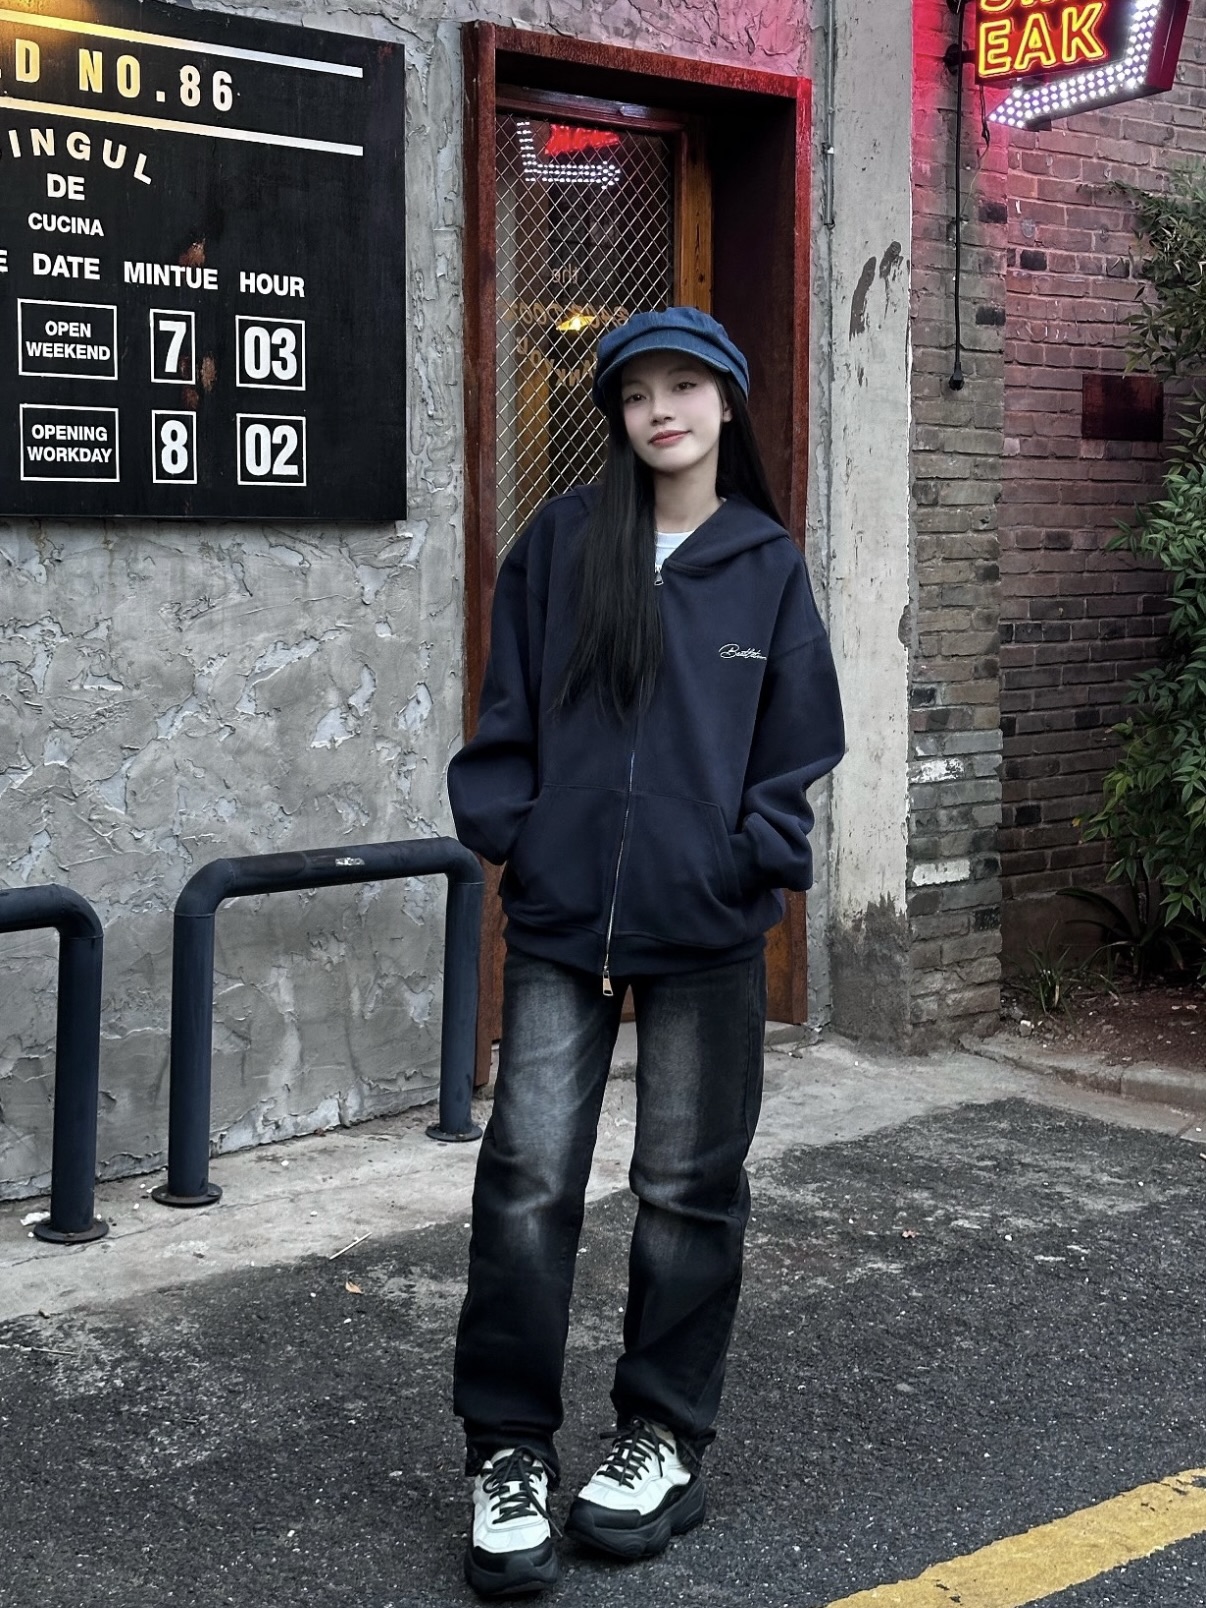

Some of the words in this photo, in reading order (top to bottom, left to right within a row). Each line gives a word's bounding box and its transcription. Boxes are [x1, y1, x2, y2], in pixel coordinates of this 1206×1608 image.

[978, 2, 1105, 77] EAK
[0, 39, 41, 84] D
[78, 47, 234, 112] NO.86
[46, 173, 86, 200] DE
[27, 212, 105, 237] CUCINA
[32, 253, 101, 280] DATE
[124, 261, 219, 290] MINTUE
[239, 271, 305, 297] HOUR
[25, 341, 111, 361] WEEKEND
[44, 320, 92, 338] OPEN
[158, 319, 187, 373] 7
[244, 326, 298, 381] 03
[26, 446, 113, 463] WORKDAY
[31, 424, 108, 441] OPENING
[160, 419, 189, 475] 8
[244, 423, 299, 477] 02
